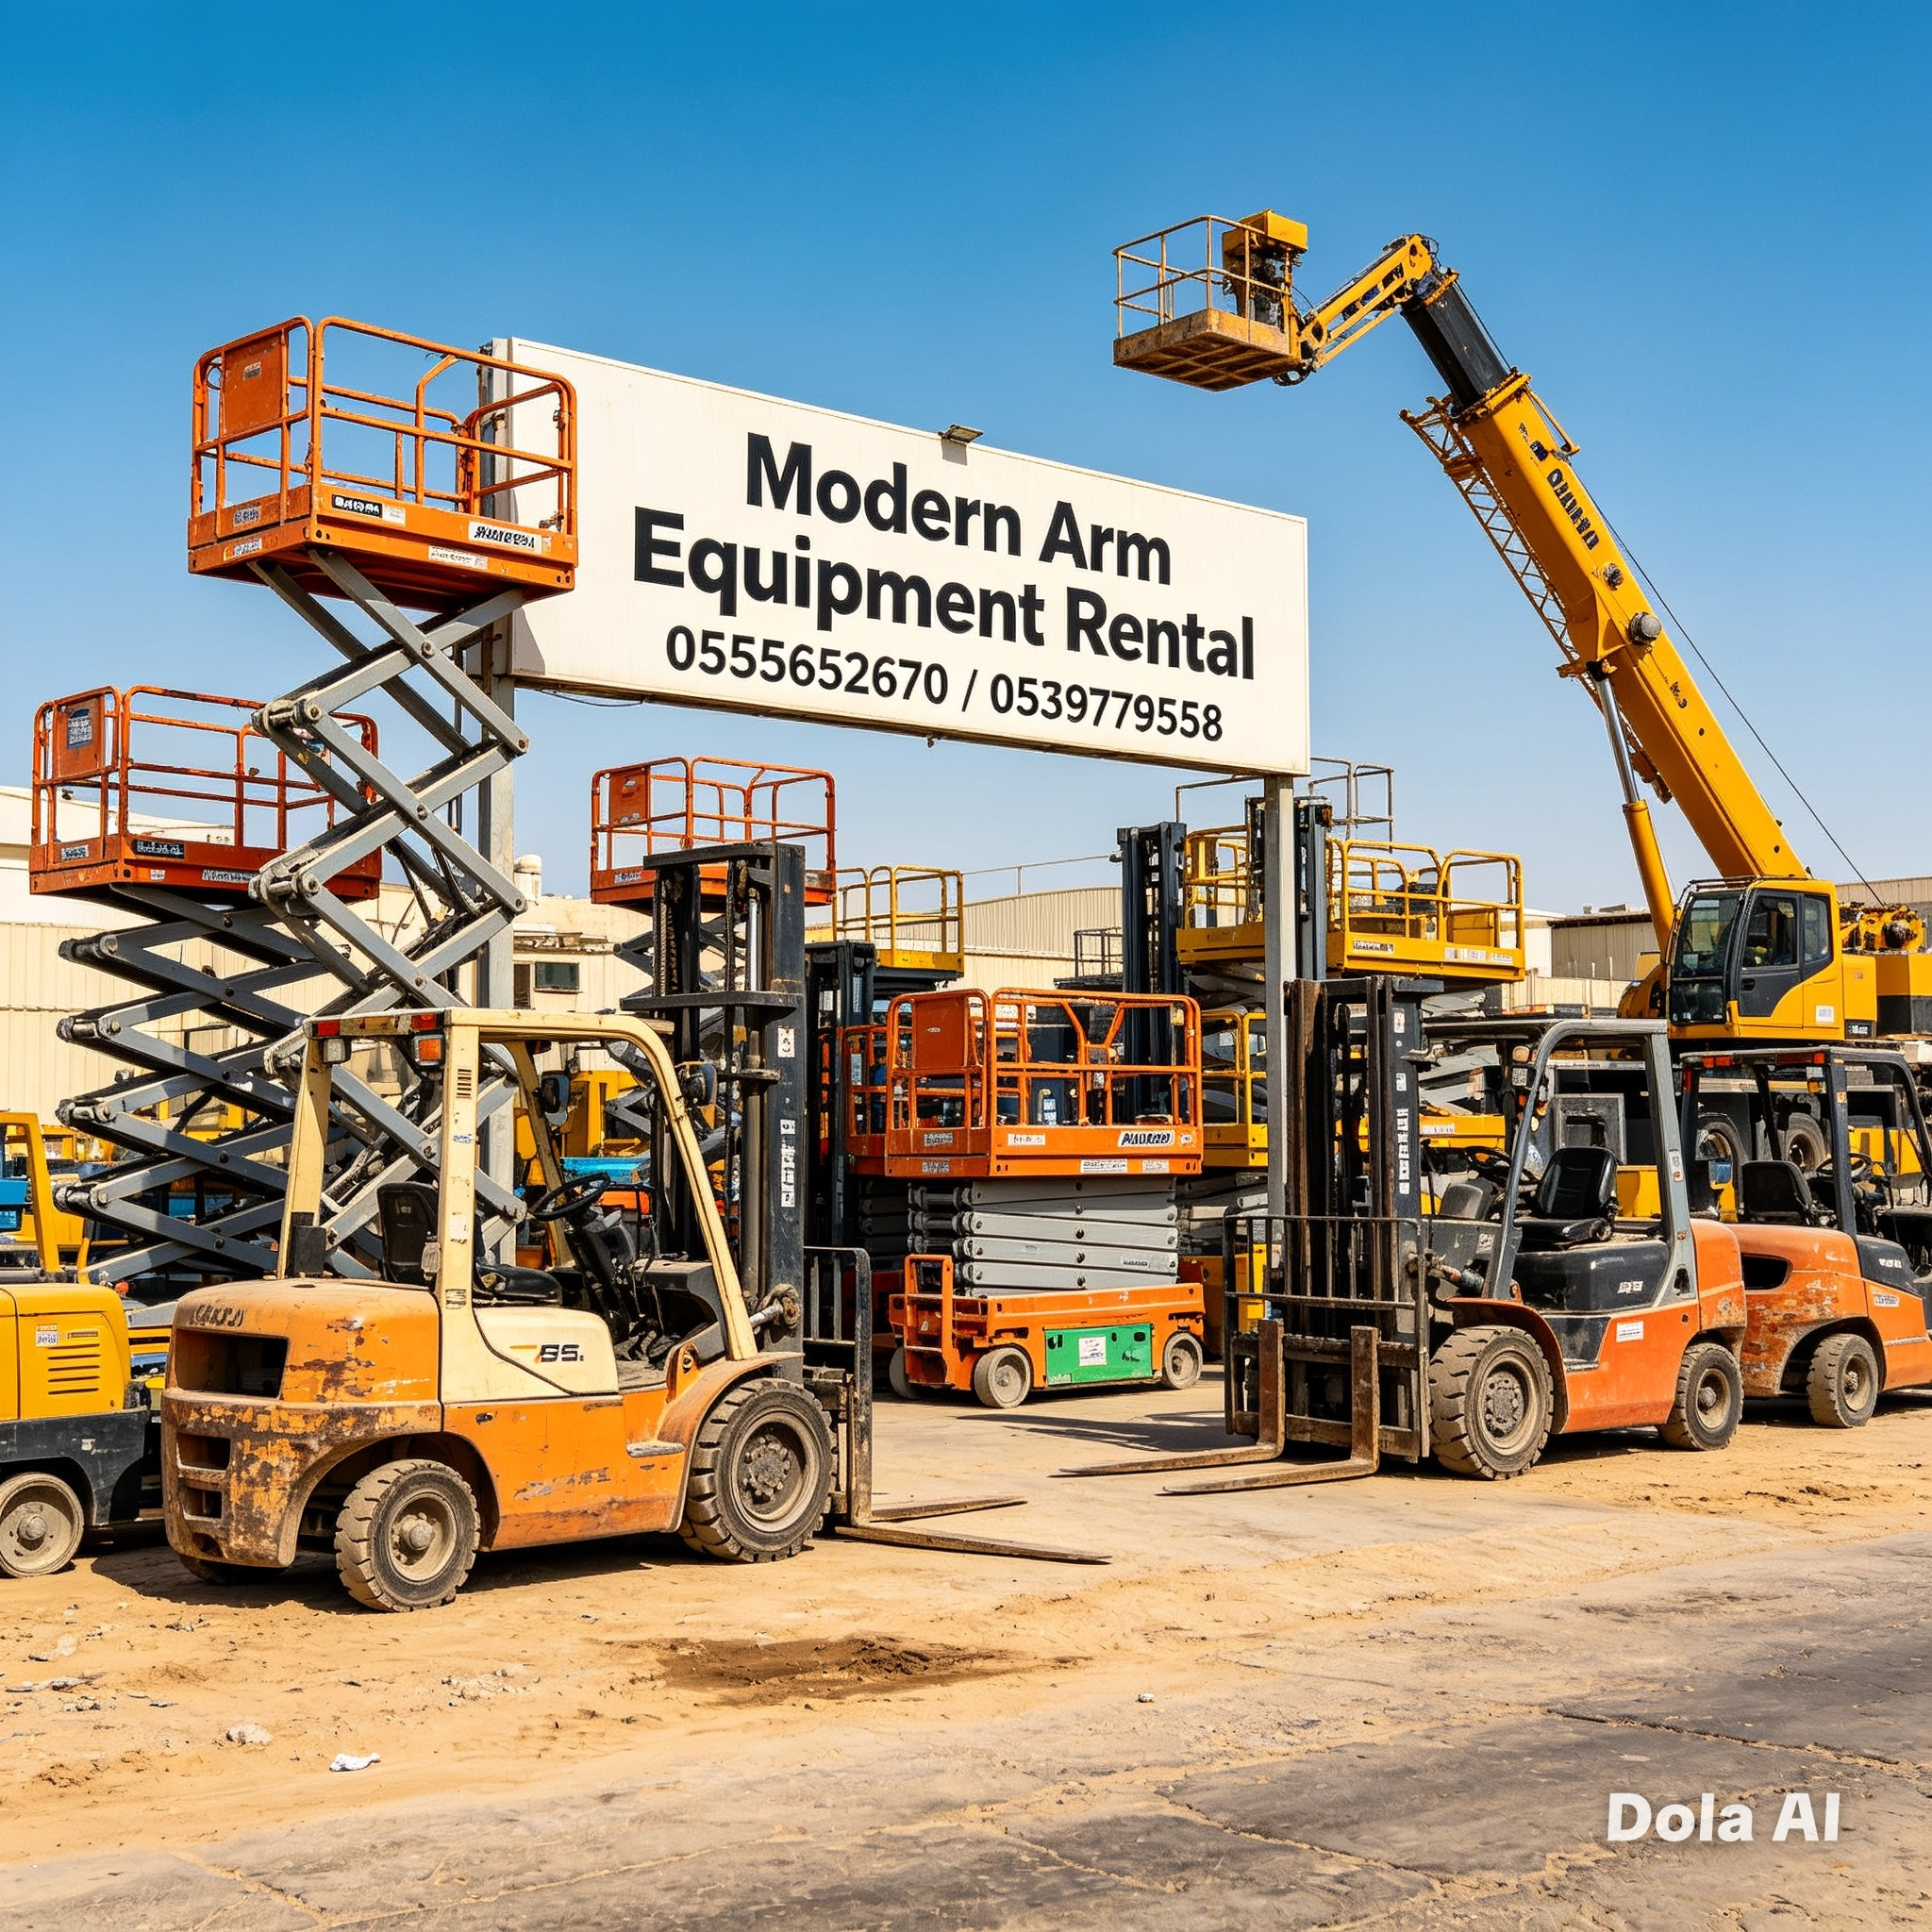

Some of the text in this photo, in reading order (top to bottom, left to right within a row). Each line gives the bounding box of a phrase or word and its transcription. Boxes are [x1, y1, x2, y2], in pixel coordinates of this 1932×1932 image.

[747, 432, 1172, 586] Modern Arm
[634, 506, 1255, 680] Equipment Rental
[666, 625, 1224, 741] 0555652670 / 0539779558
